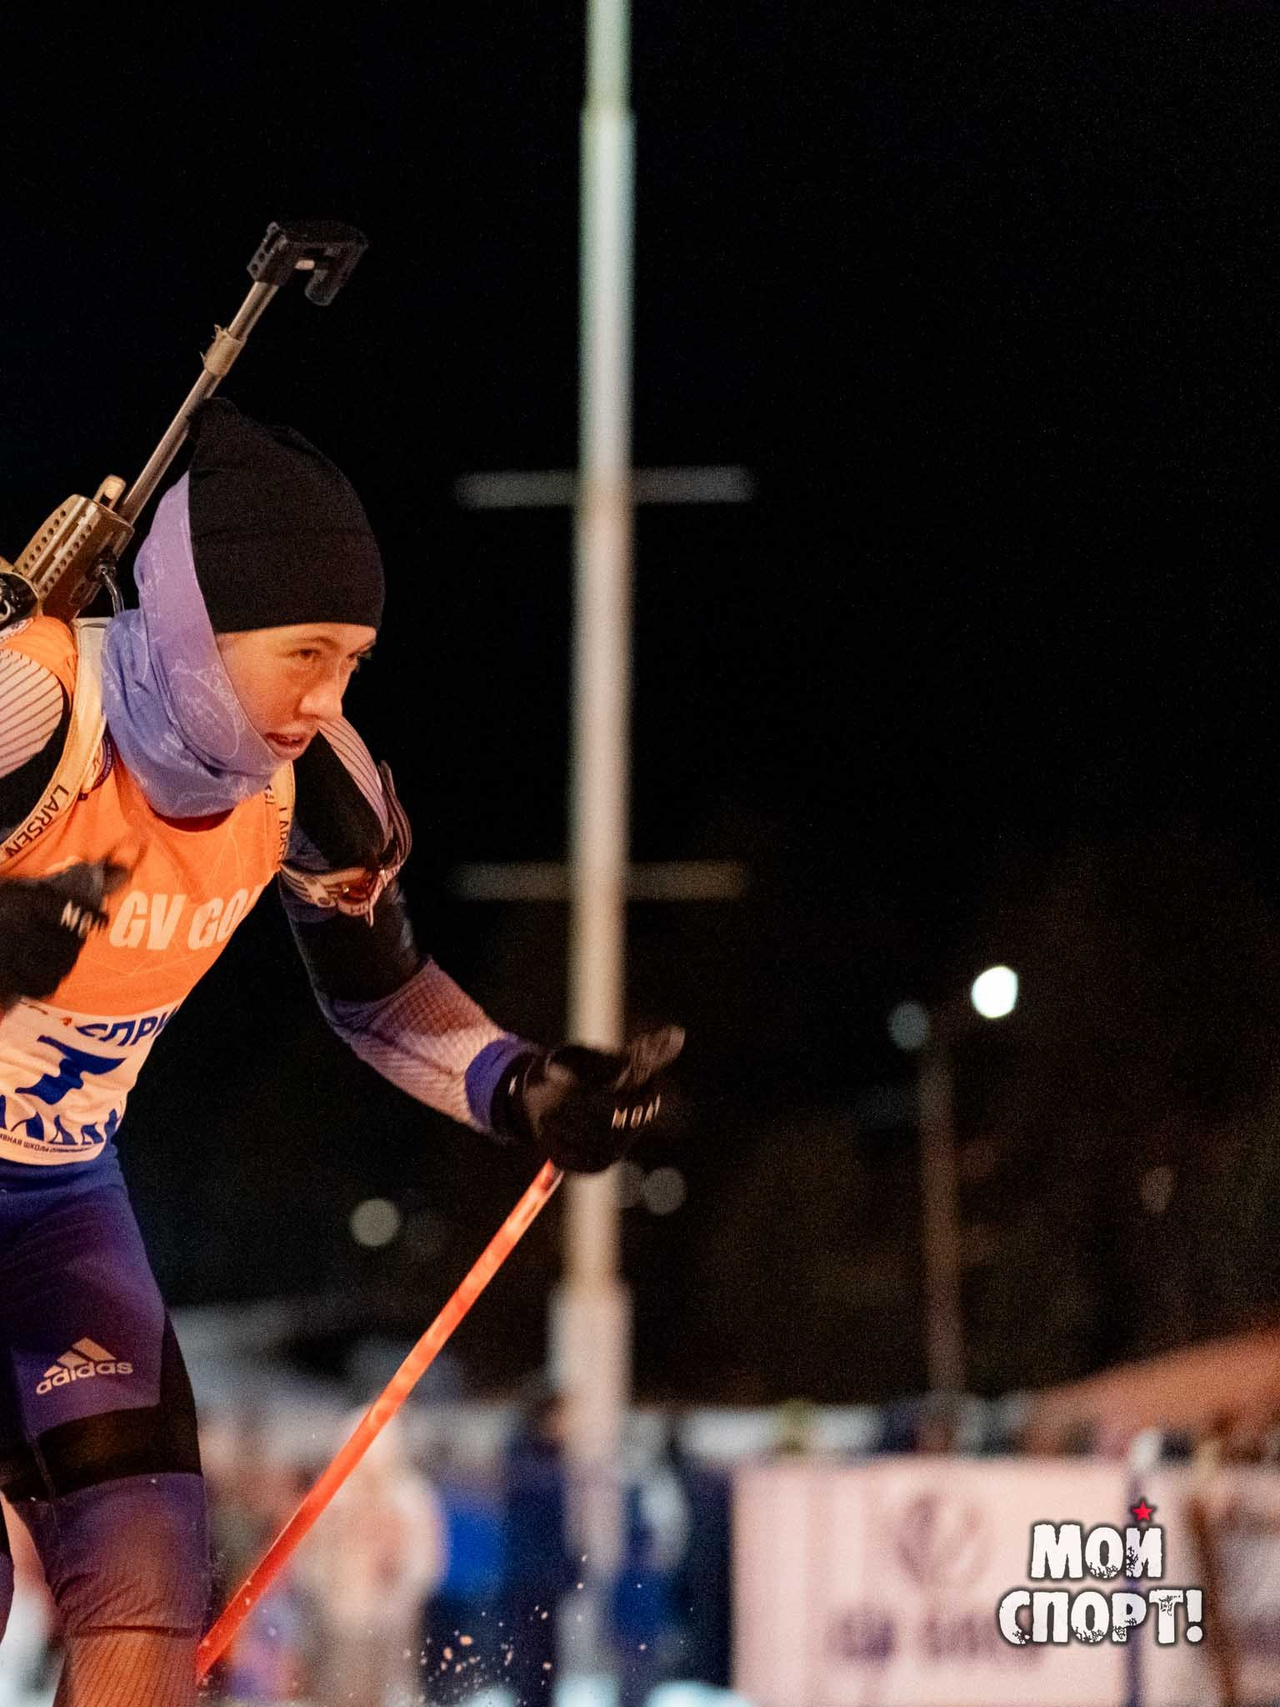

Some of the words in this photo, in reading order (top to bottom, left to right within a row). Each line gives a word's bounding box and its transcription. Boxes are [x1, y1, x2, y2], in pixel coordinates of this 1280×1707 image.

[4, 784, 69, 857] LARSEN
[109, 891, 187, 950] GV
[36, 1361, 133, 1395] adidas
